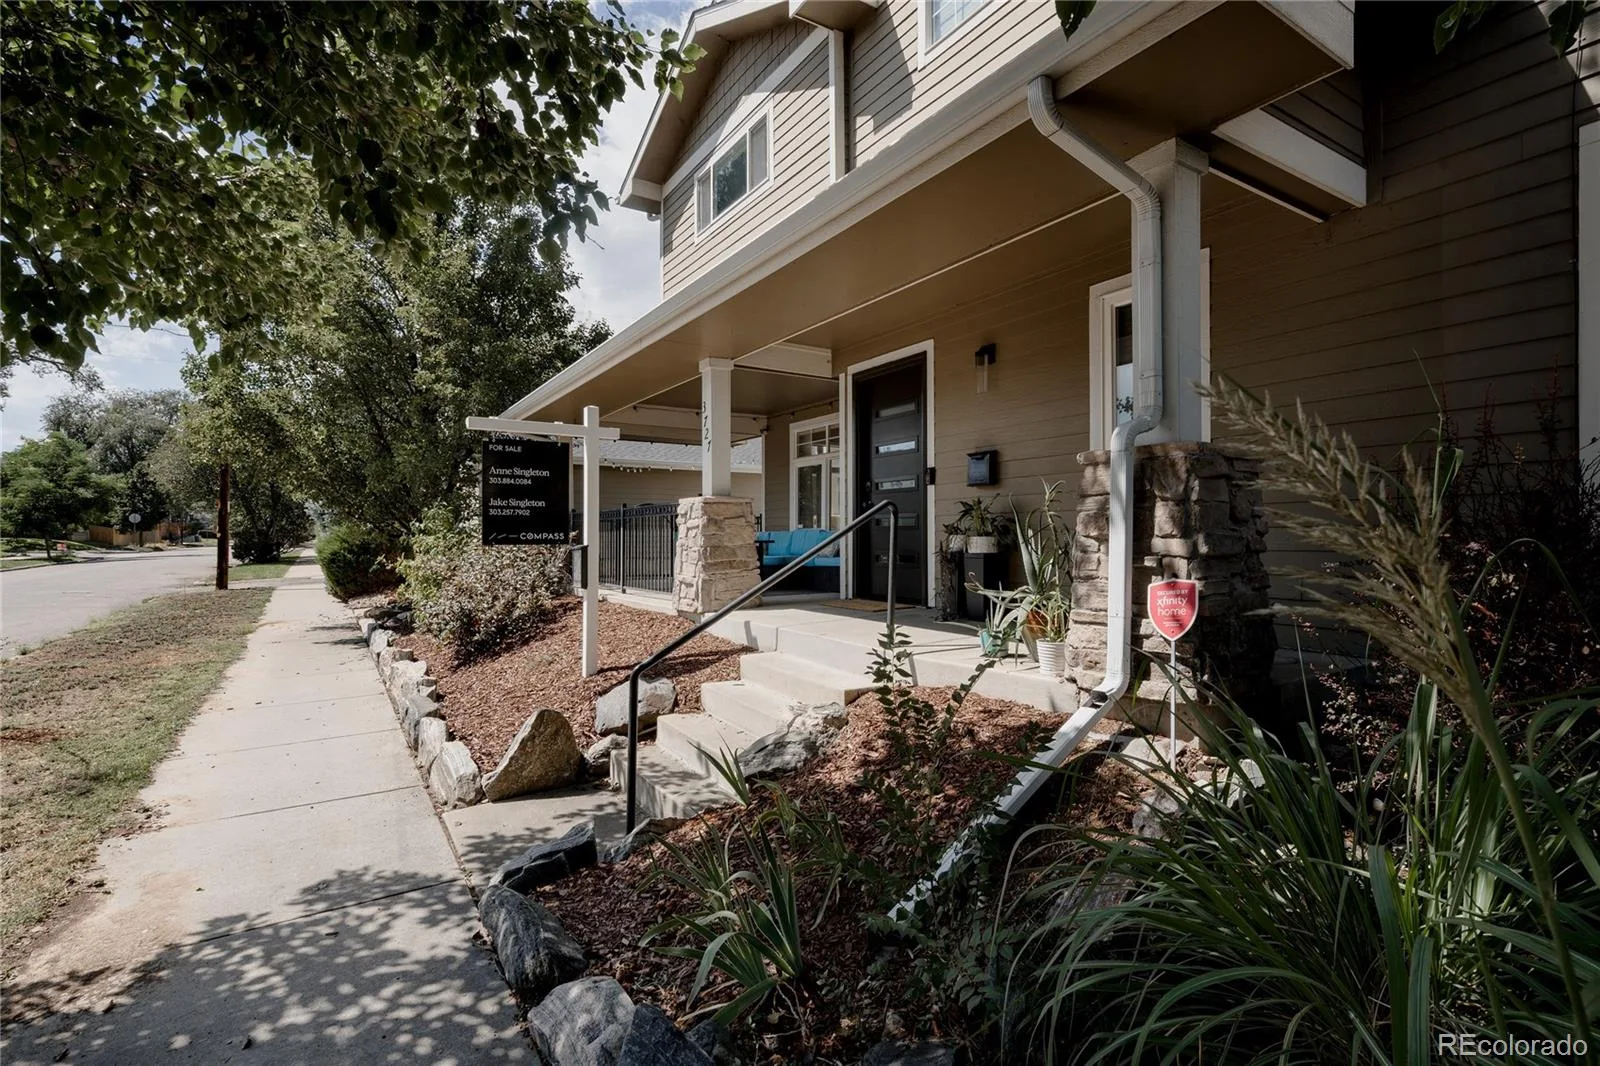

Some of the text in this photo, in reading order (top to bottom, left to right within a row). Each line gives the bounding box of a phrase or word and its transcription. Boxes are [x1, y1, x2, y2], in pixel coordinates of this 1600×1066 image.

[489, 466, 550, 477] Anne Singleton
[489, 498, 546, 508] Jake Singleton
[520, 532, 565, 540] COMPASS
[1157, 596, 1187, 607] xfinity
[1157, 607, 1186, 616] home
